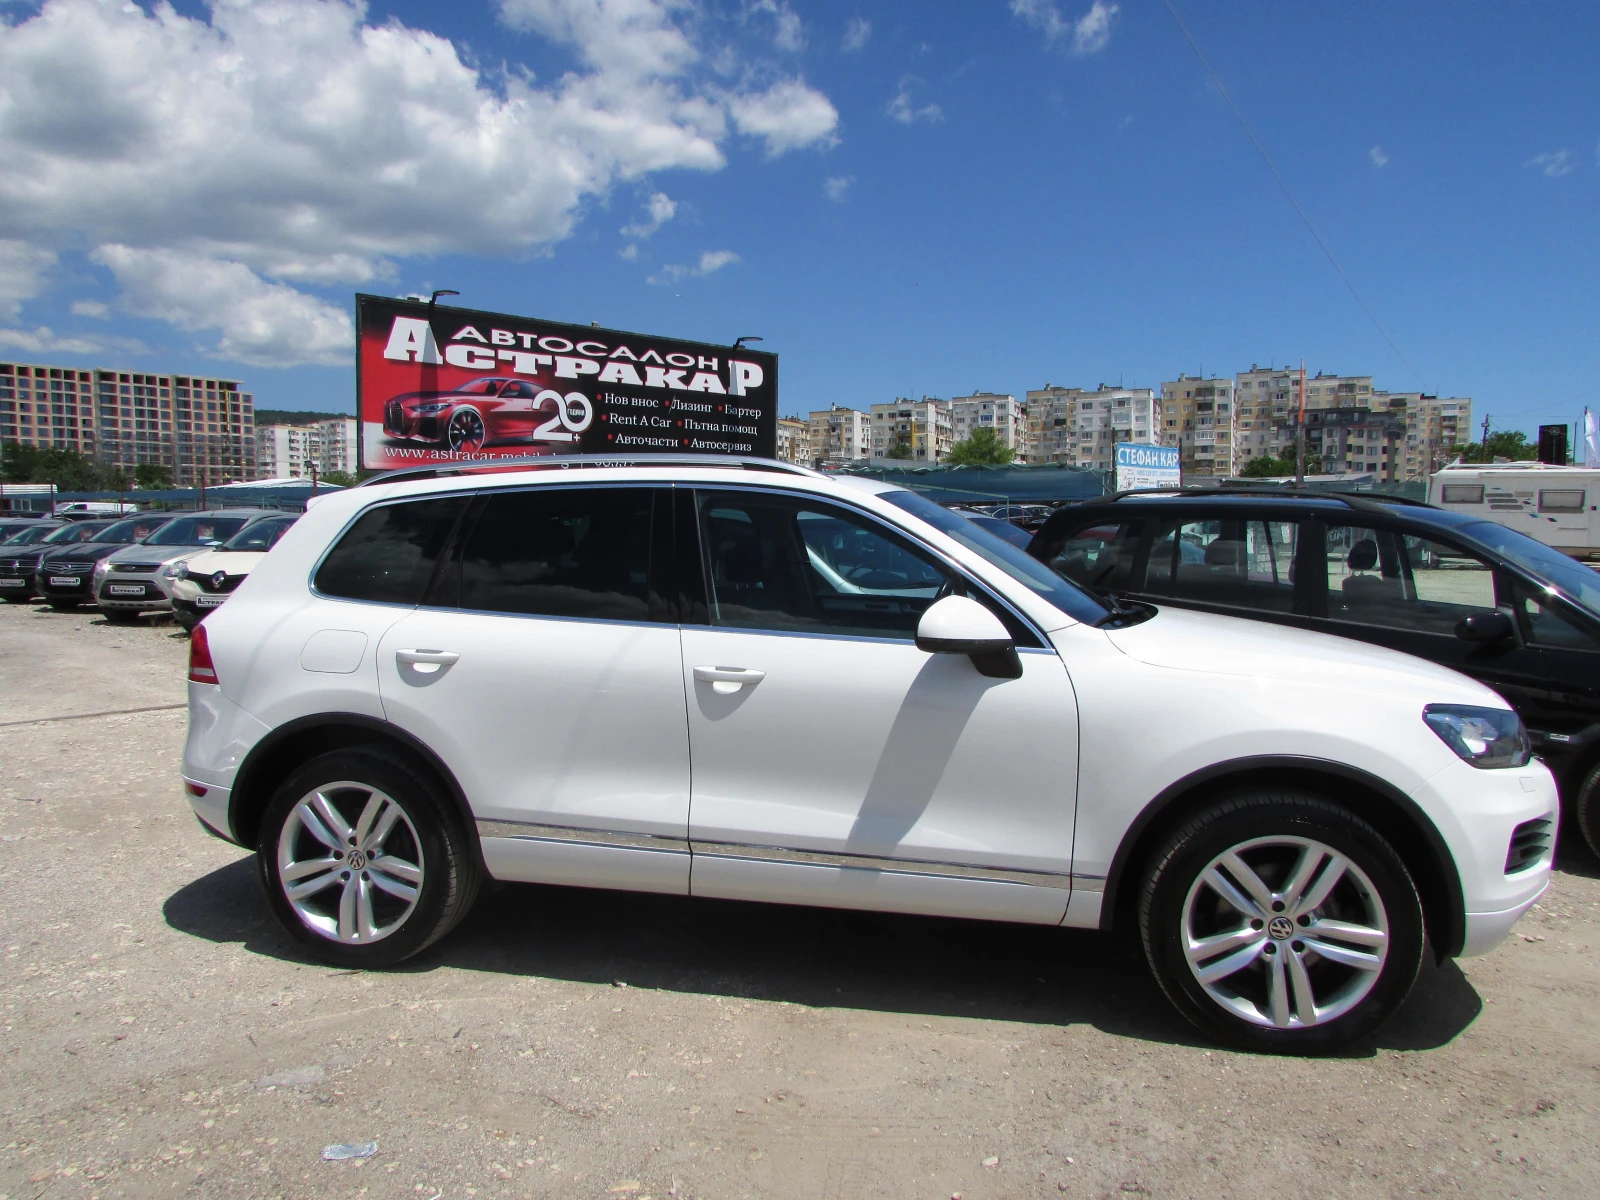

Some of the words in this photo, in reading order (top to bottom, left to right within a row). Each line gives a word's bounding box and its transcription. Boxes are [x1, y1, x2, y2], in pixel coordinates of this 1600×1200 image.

[383, 316, 764, 396] АСТРАКАР
[451, 326, 719, 370] АВТОСАЛОН
[604, 393, 629, 406] Нов
[631, 397, 659, 408] внос
[671, 400, 713, 413] Лизинг
[725, 404, 762, 419] Бартер
[609, 413, 638, 426] Rent
[640, 415, 649, 427] A
[651, 416, 672, 428] Car
[684, 419, 720, 432] Пътна
[721, 424, 758, 436] помощ
[615, 433, 679, 447] Авточасти
[691, 438, 752, 453] Автосервиз
[1118, 448, 1158, 466] СТЕФАН
[1160, 452, 1179, 467] КАР
